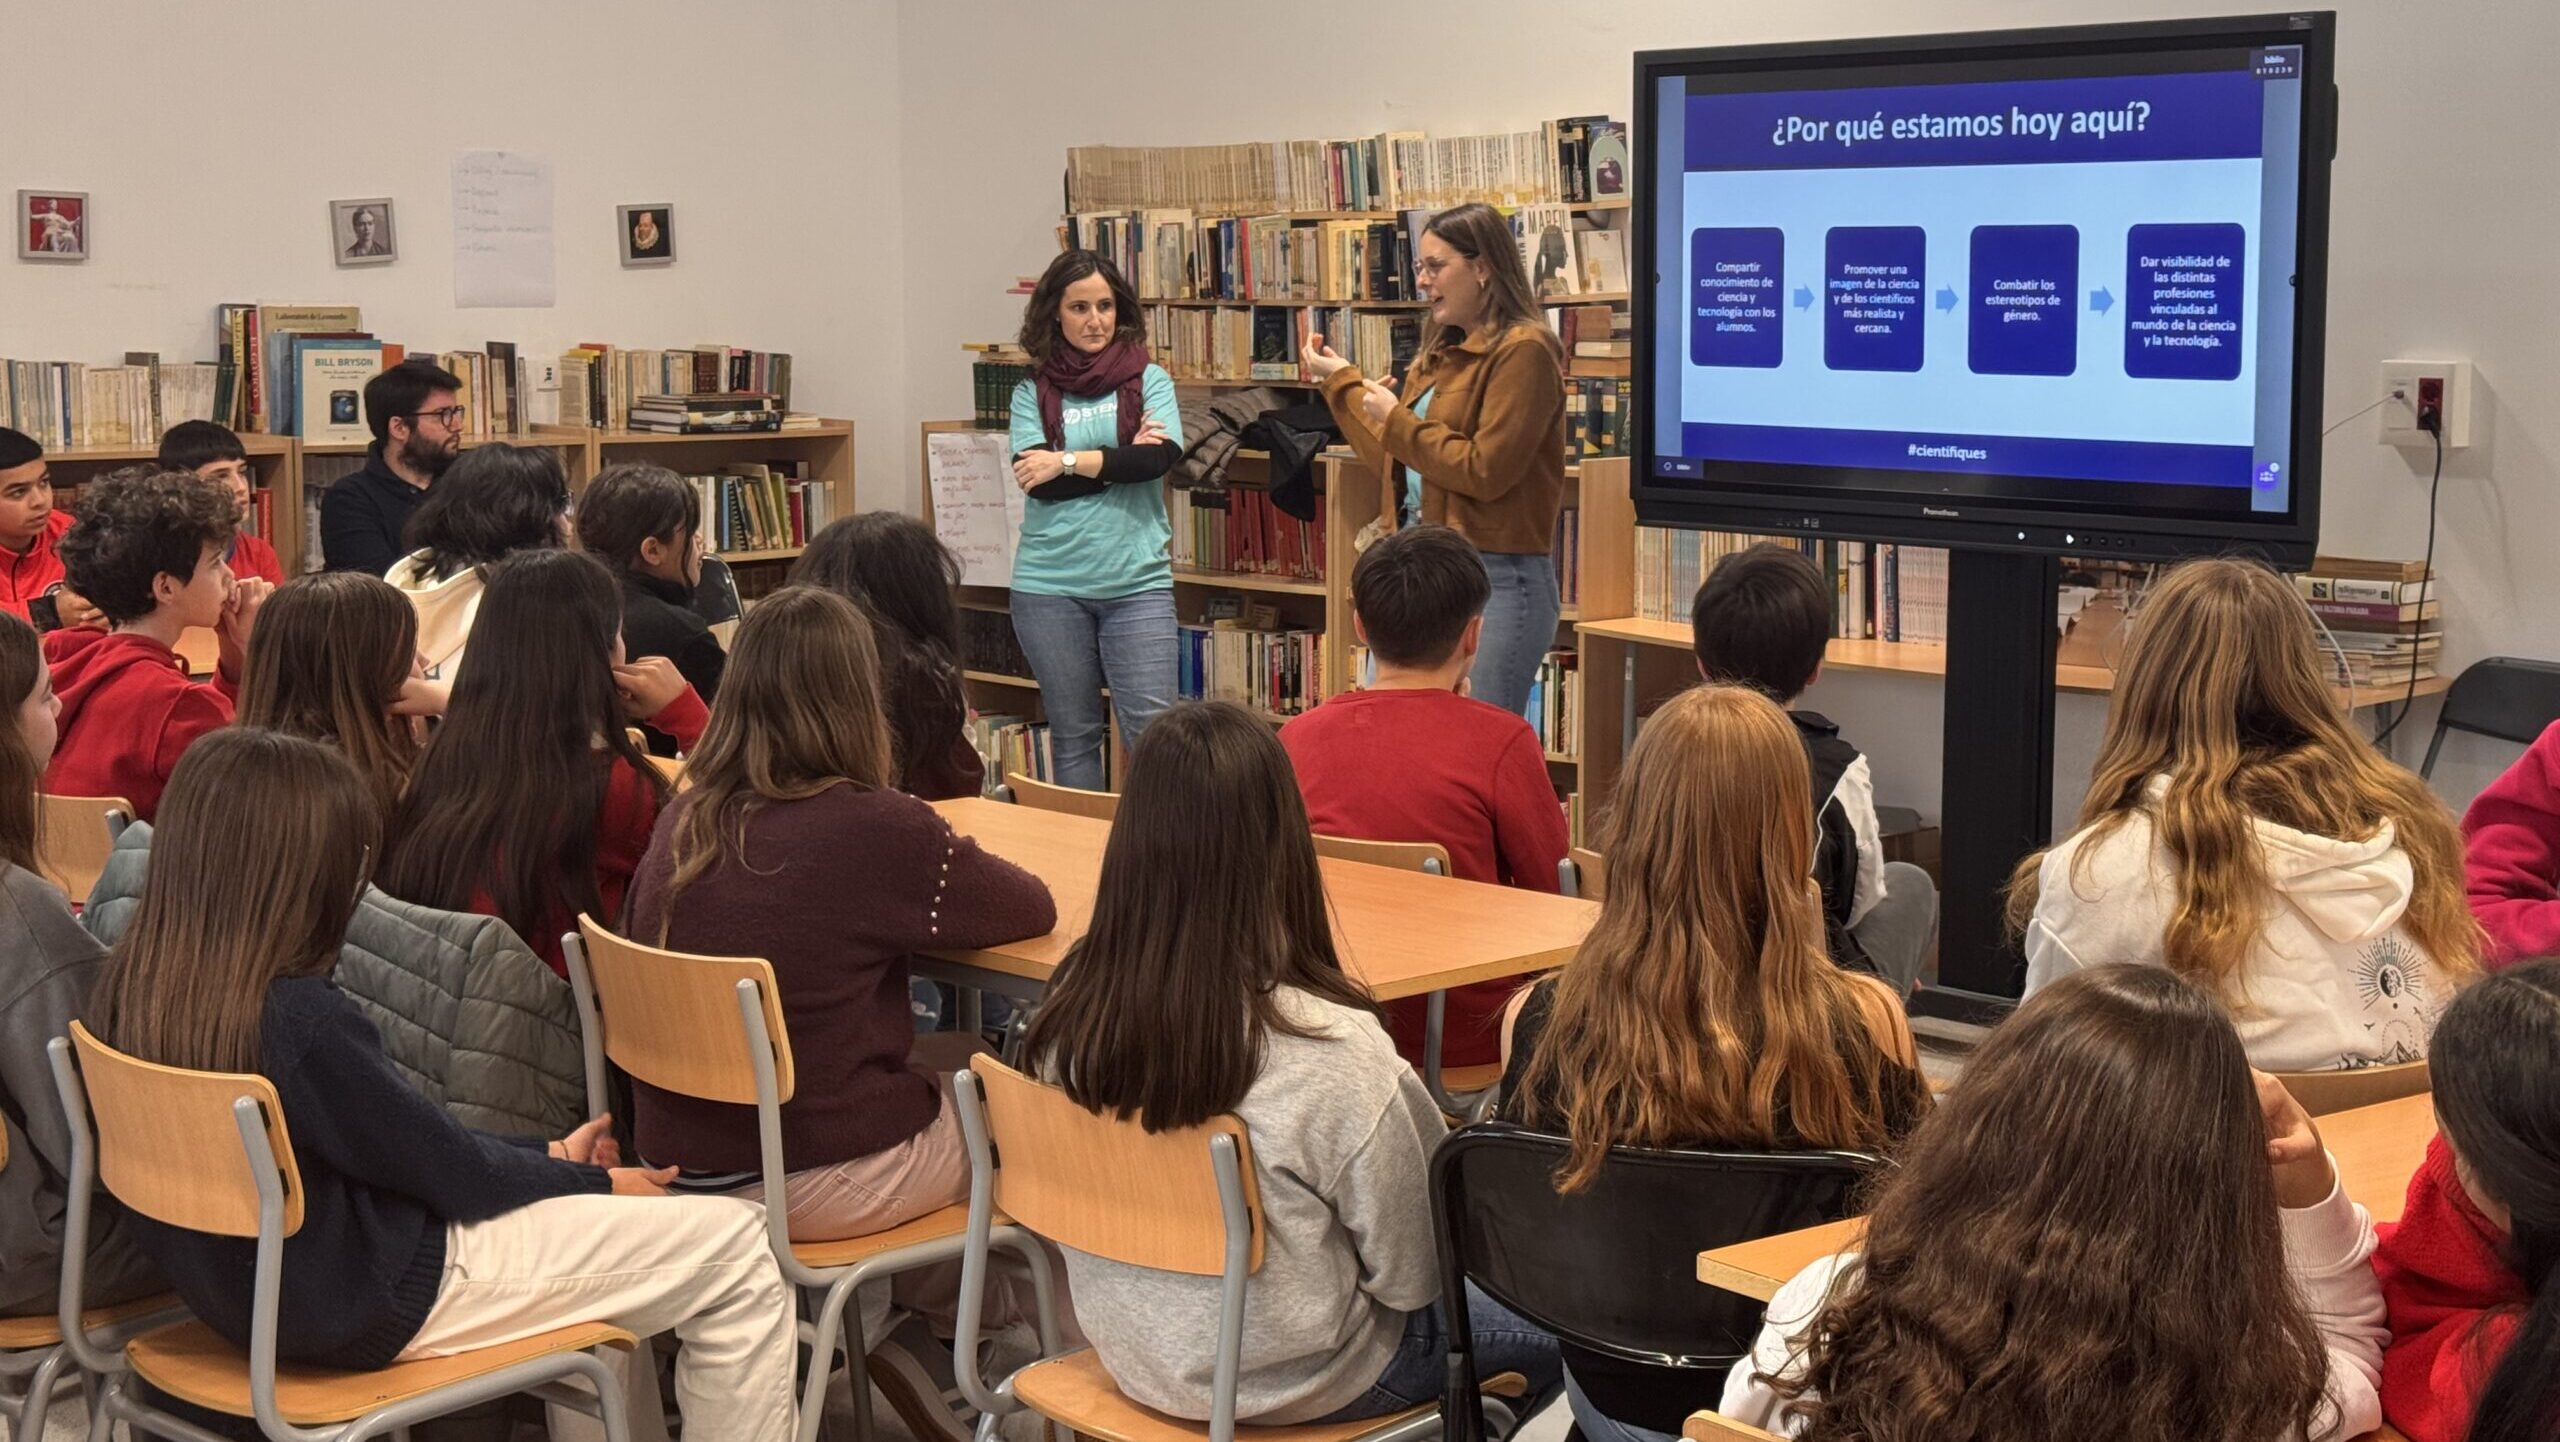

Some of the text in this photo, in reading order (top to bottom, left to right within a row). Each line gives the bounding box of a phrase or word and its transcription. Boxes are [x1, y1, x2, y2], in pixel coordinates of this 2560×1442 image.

[1772, 100, 2151, 147] ¿Por qué estamos hoy aquí?
[1716, 262, 1761, 274] Compartir
[2140, 256, 2231, 268] Dar visibilidad de
[1844, 264, 1907, 275] Promover una
[1700, 276, 1773, 288] conocimiento de
[2153, 271, 2216, 283] las distintas
[1829, 278, 1920, 291] imagen de la ciencia
[1993, 279, 2056, 291] Combatir los
[1717, 292, 1756, 305] ciencia y
[1833, 295, 1840, 305] y
[1841, 293, 1853, 304] de
[1854, 293, 1868, 304] los
[2153, 287, 2216, 301] profesiones
[1985, 295, 2061, 308] estereotipos de
[1744, 308, 1761, 318] con
[1762, 307, 1776, 318] los
[1844, 308, 1905, 321] más realista y
[2150, 303, 2218, 315] vinculadas al
[2003, 309, 2041, 323] género.
[1716, 321, 1756, 332] alumnos.
[1854, 324, 1892, 334] cercana.
[2131, 320, 2237, 332] mundo de la ciencia
[2143, 335, 2223, 348] y la tecnología.
[314, 358, 373, 367] BILL BRYSON
